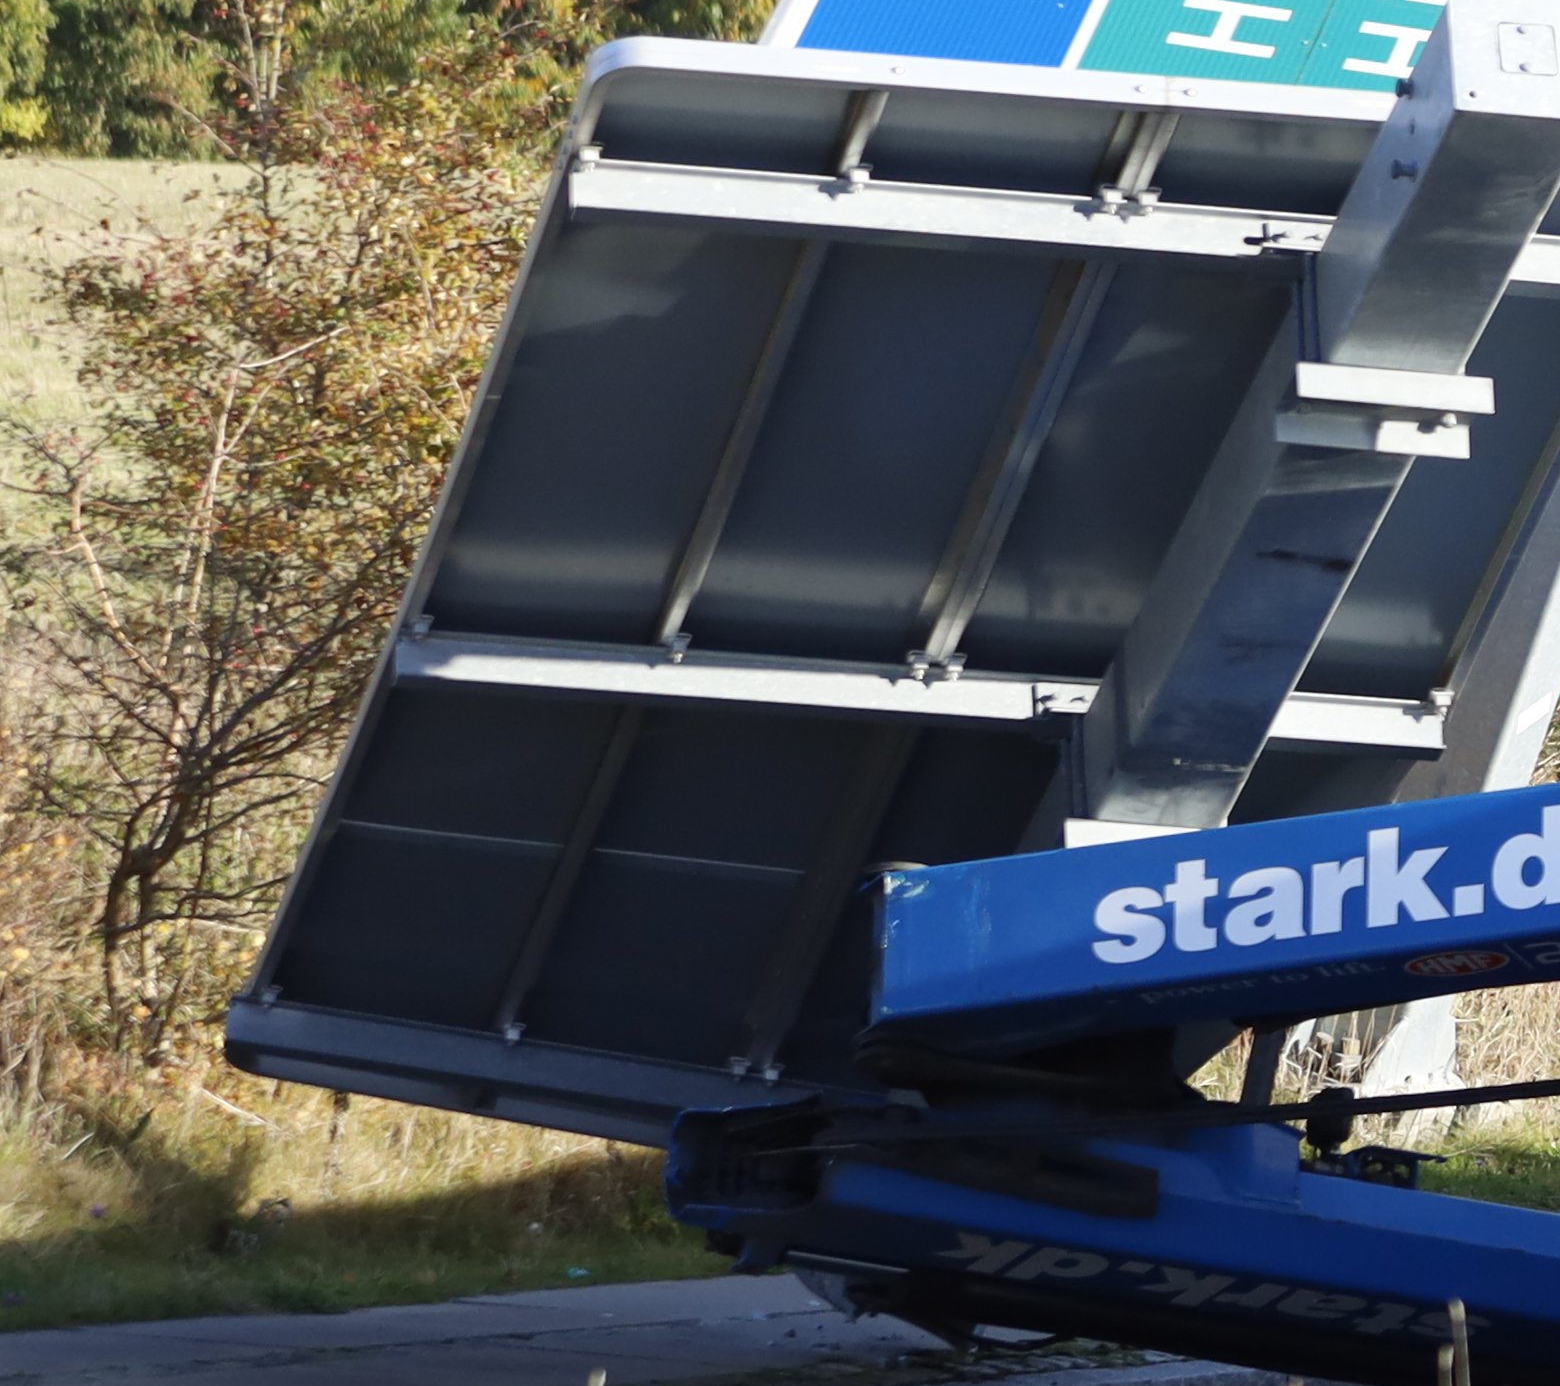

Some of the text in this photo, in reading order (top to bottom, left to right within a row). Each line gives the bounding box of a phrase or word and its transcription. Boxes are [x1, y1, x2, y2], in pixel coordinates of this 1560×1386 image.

[1416, 953, 1497, 976] HMF
[1139, 978, 1258, 1005] power
[1268, 971, 1310, 985] to
[938, 1232, 1492, 1341] stark.dk
